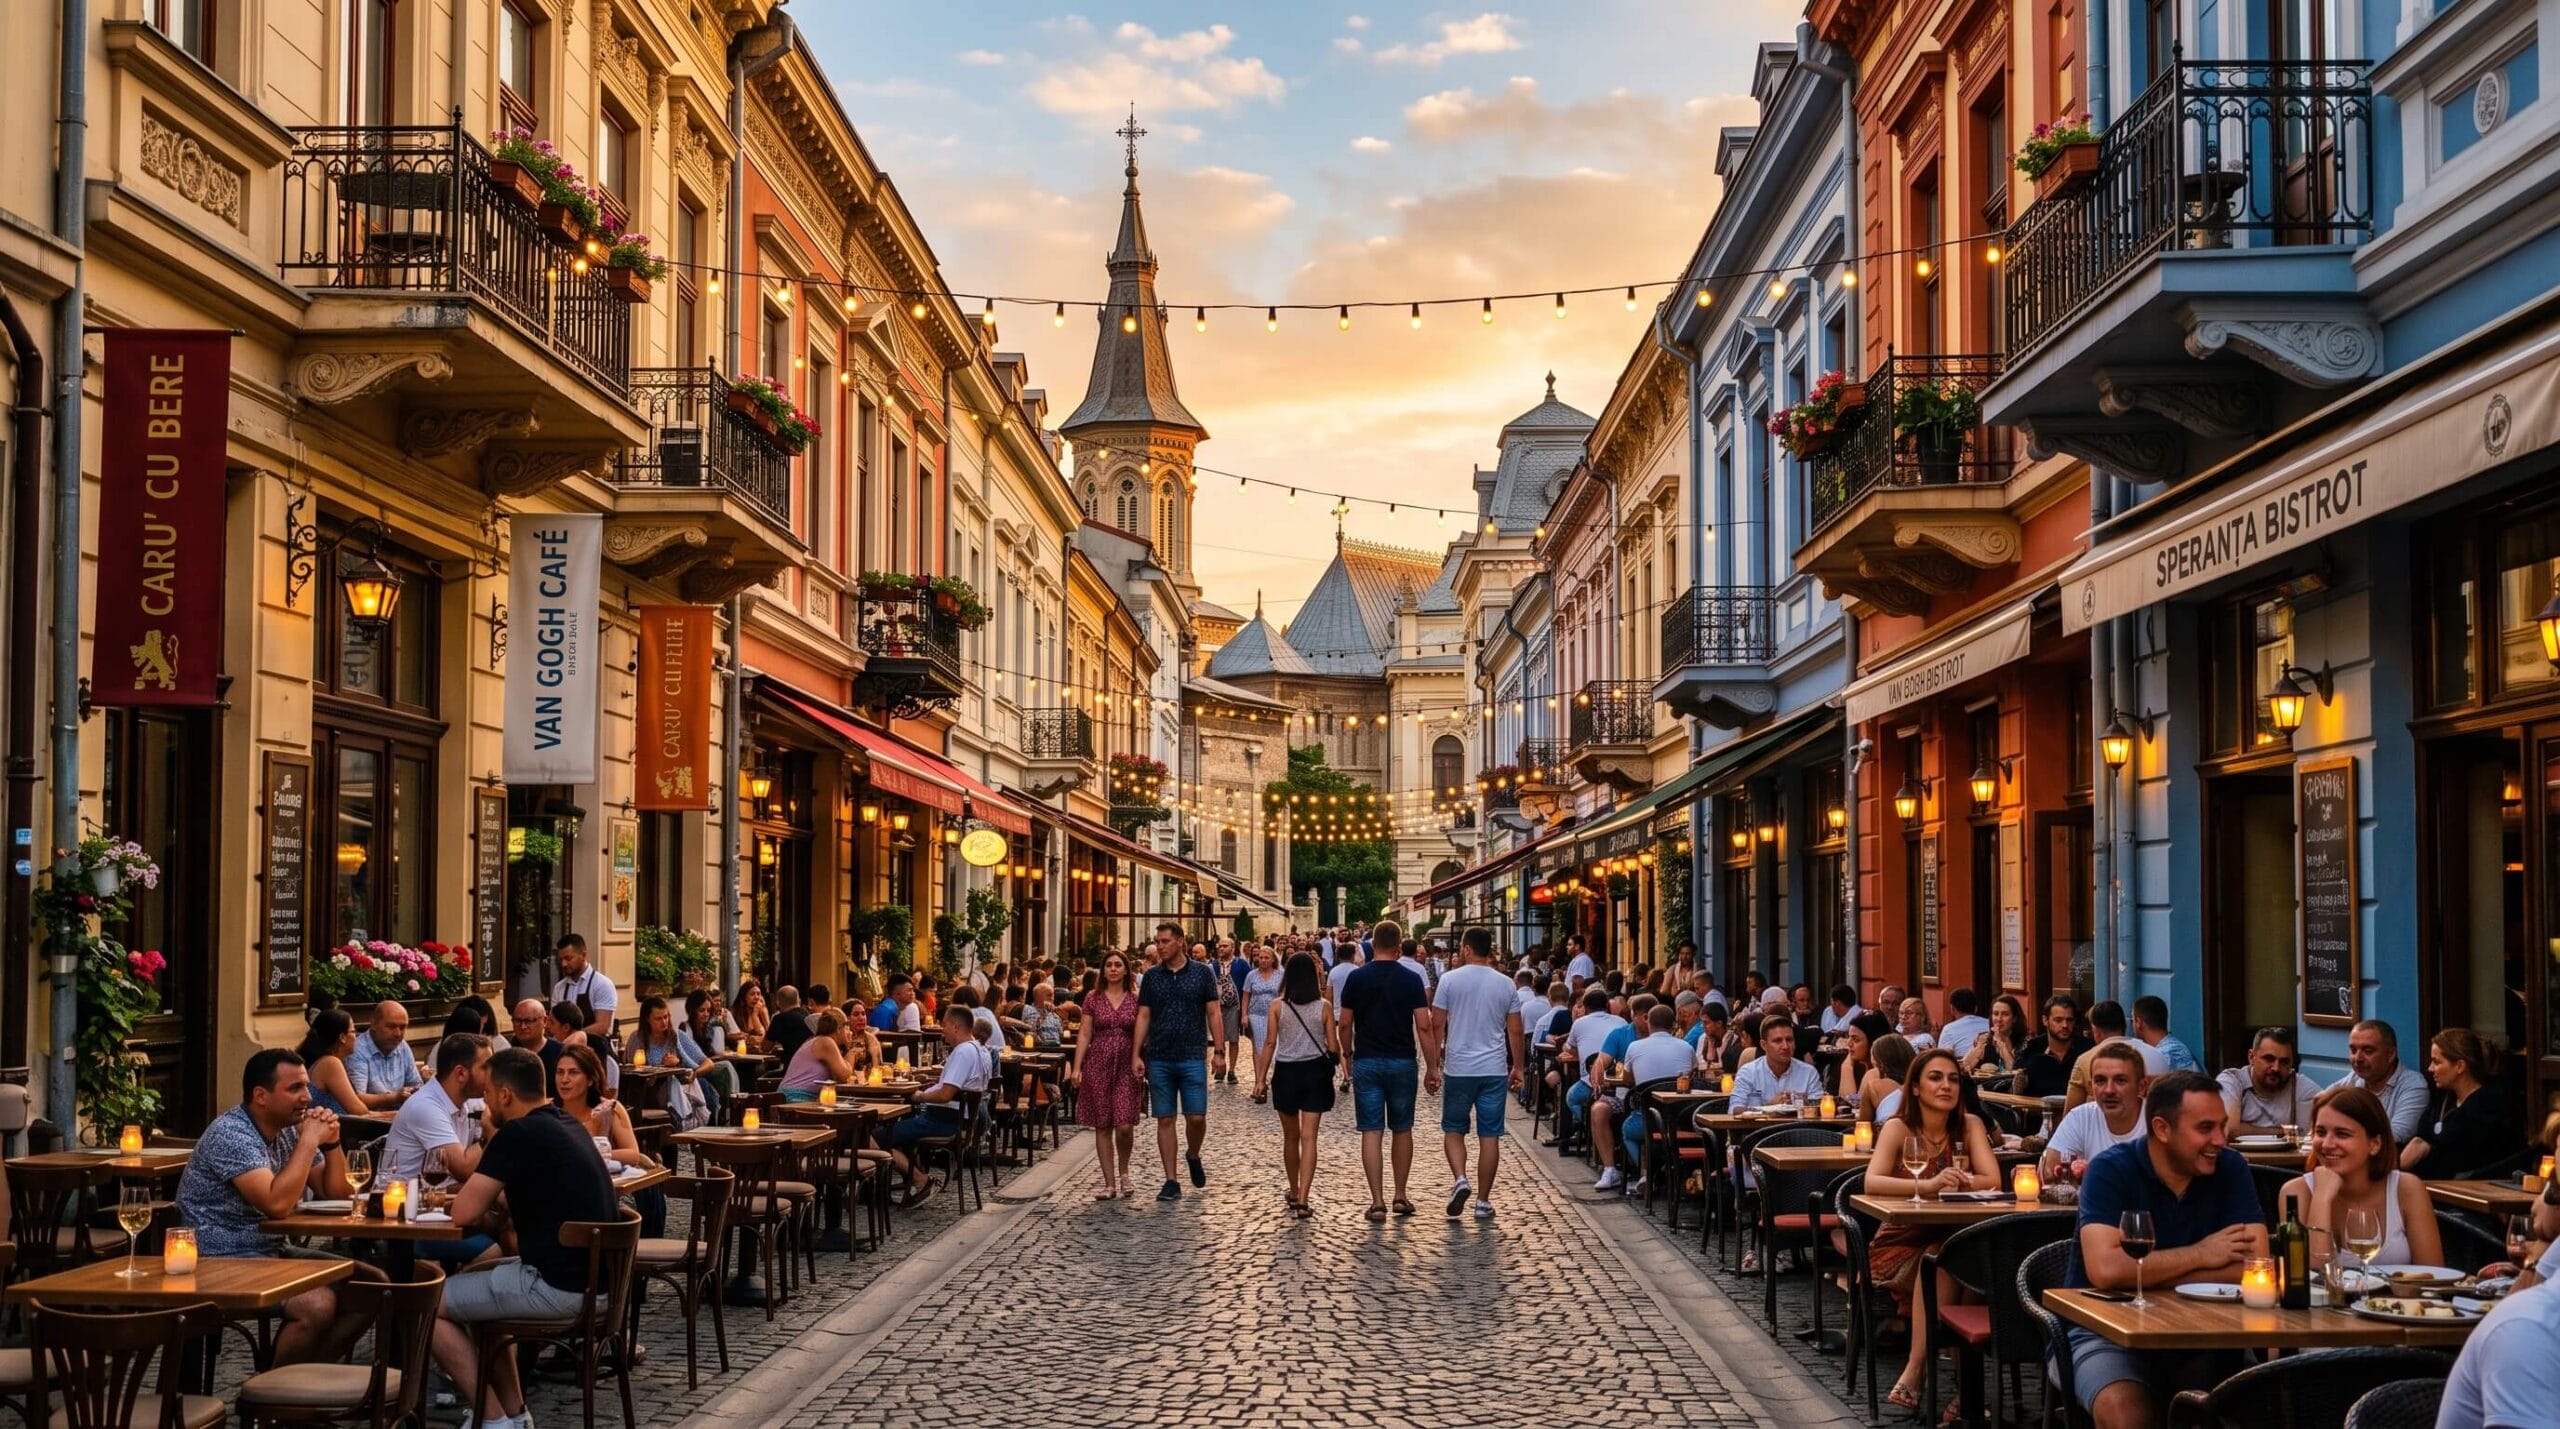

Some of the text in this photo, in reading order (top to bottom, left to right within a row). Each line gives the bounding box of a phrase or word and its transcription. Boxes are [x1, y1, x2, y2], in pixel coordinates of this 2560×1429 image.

[141, 354, 184, 616] CARU' CU BERE
[2265, 459, 2367, 544] BISTROT
[533, 529, 569, 751] VAN GOGH CAFÉ
